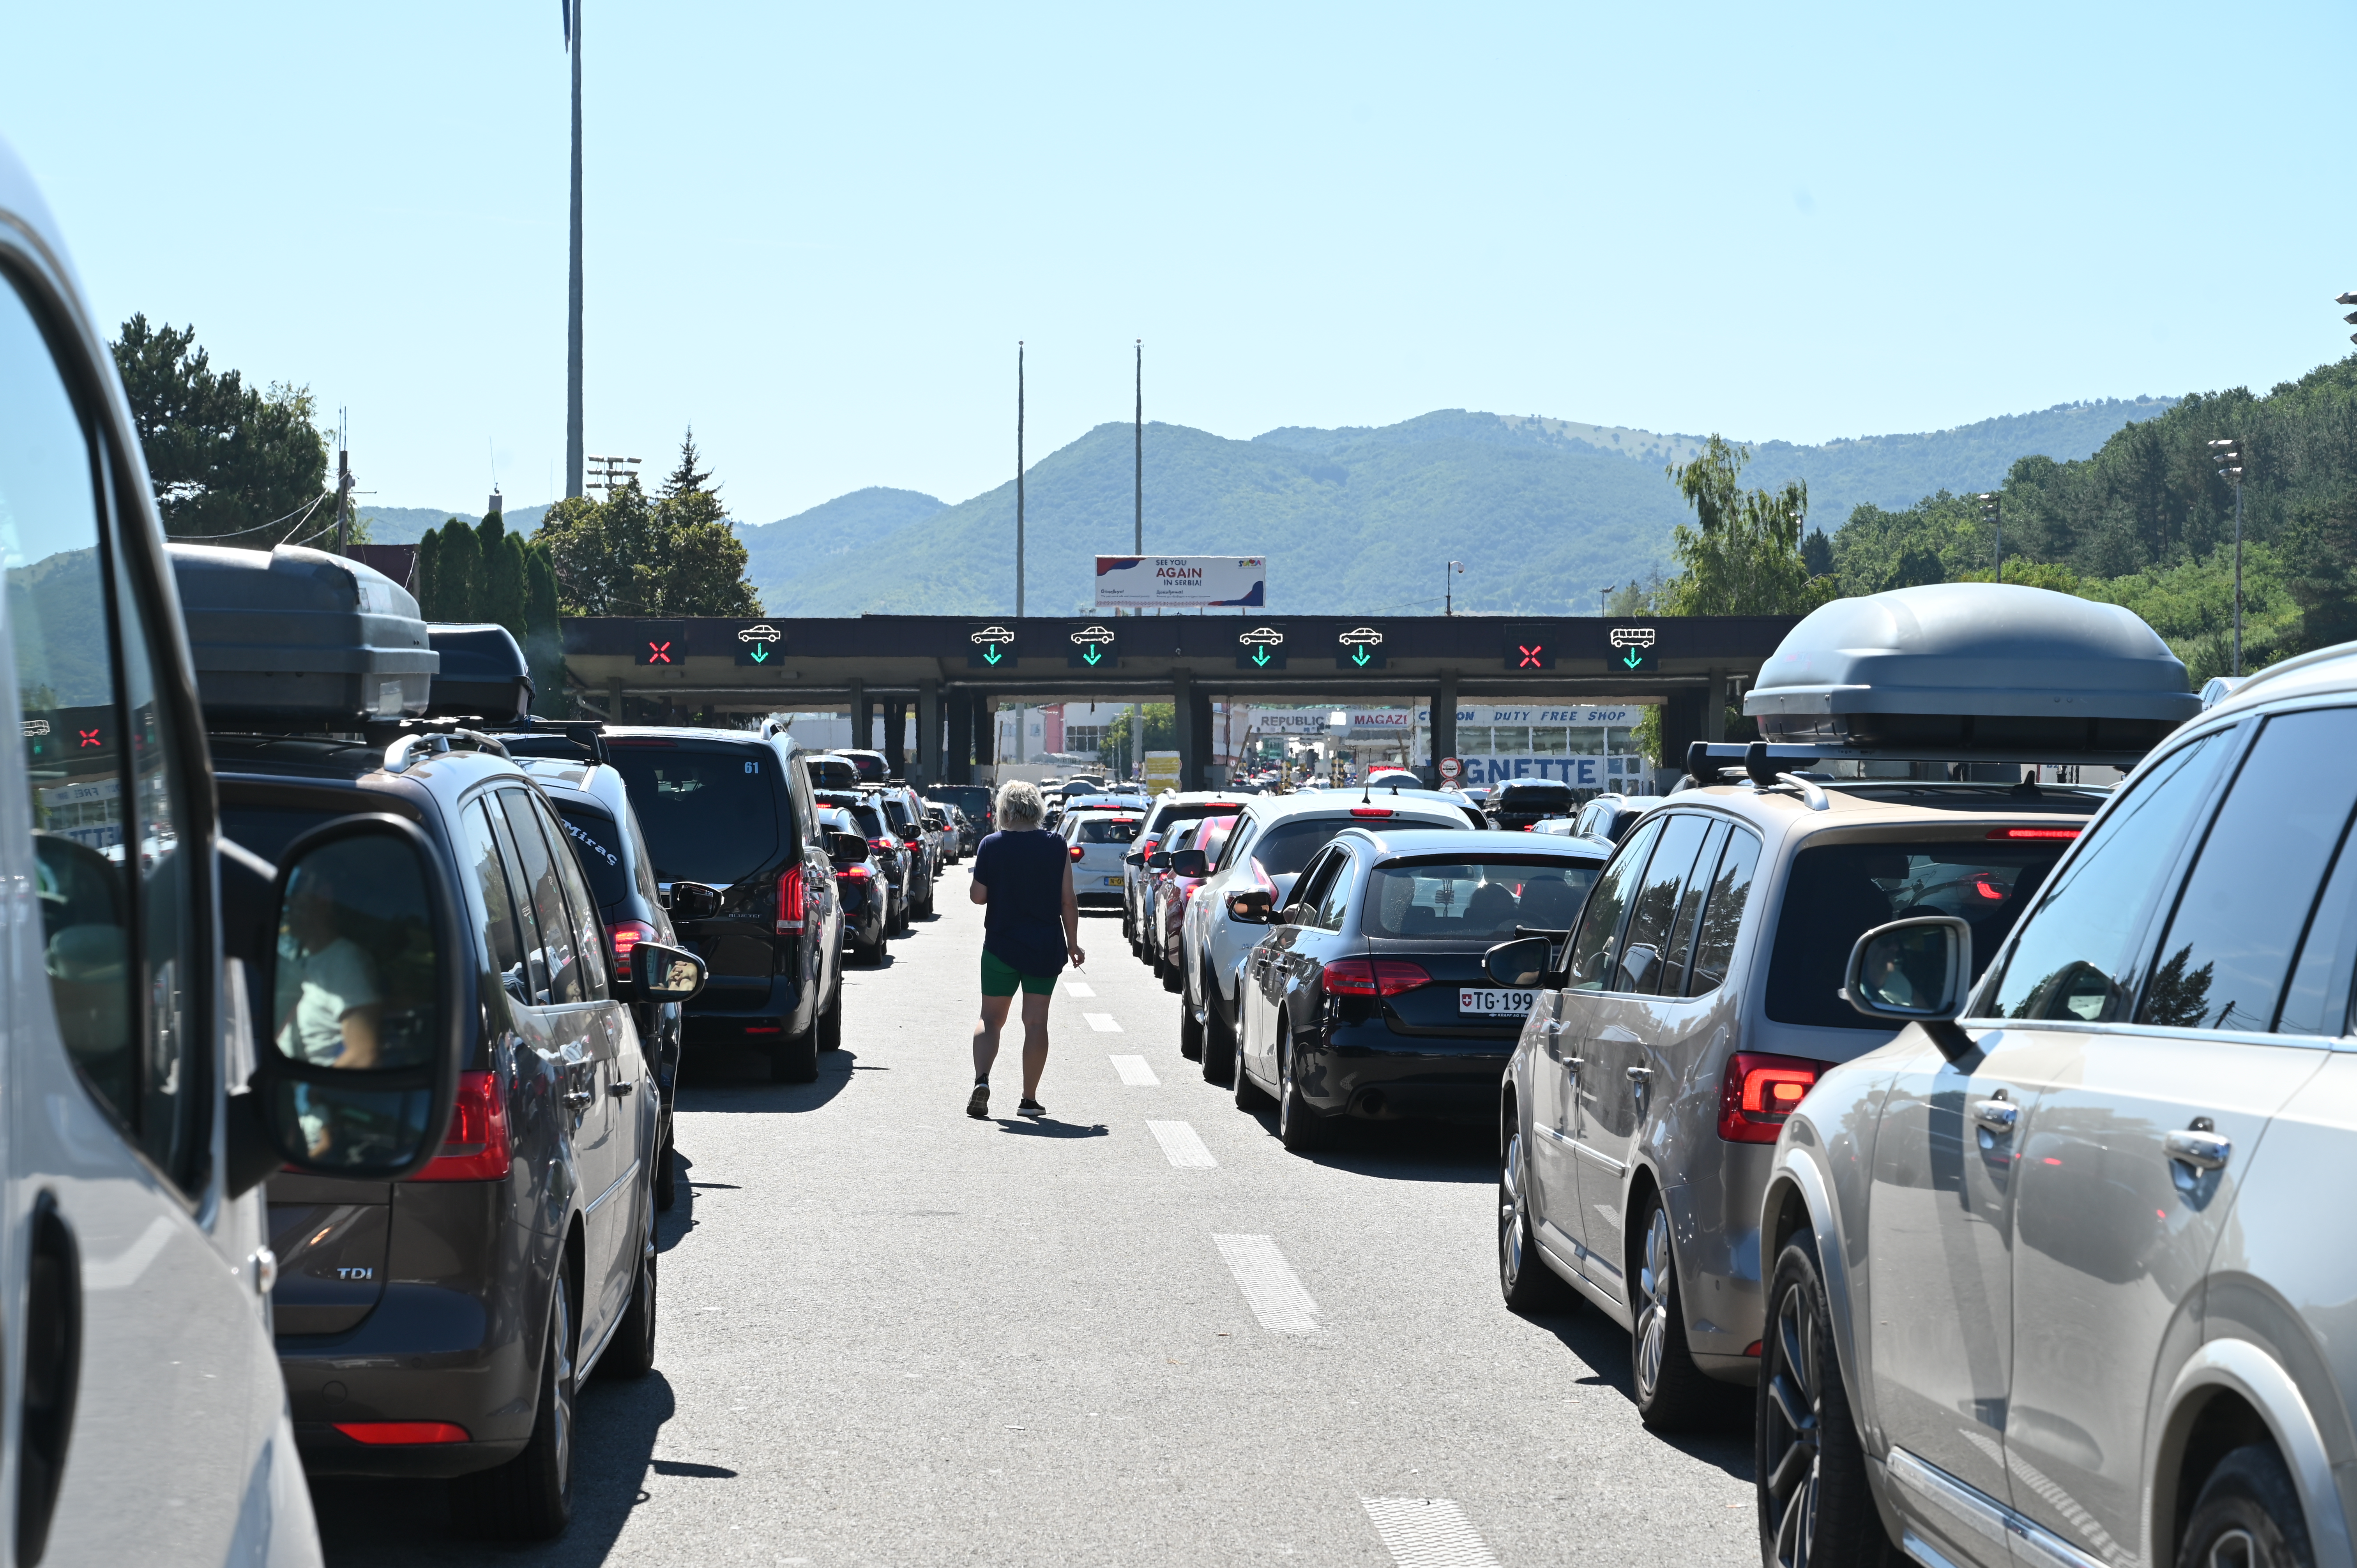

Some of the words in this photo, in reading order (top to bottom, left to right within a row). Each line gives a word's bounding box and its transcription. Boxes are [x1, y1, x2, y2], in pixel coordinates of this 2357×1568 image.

[1156, 567, 1201, 578] AGAIN
[1261, 716, 1324, 726] REPUBLIC
[1494, 712, 1530, 720] DUTY
[1541, 712, 1578, 720] FREE
[1588, 711, 1626, 720] SHOP
[744, 761, 758, 774] 61
[1463, 759, 1596, 784] GNETTE
[560, 818, 617, 866] Miraç
[337, 1268, 373, 1279] TDI
